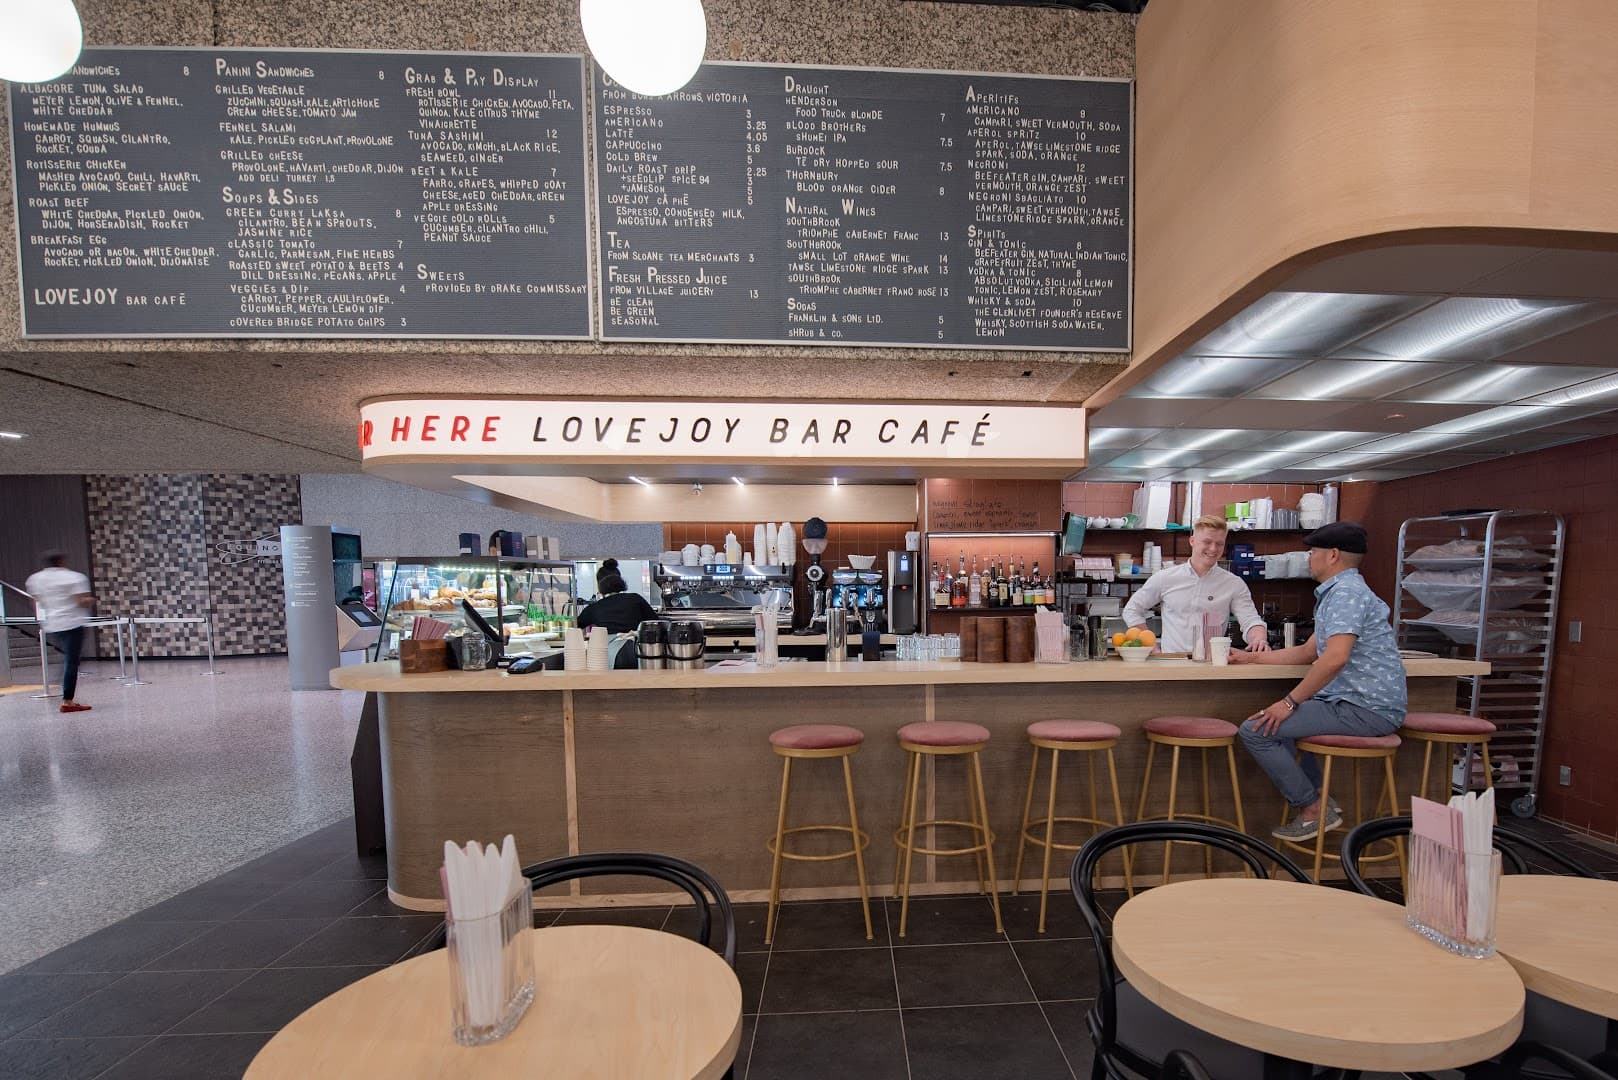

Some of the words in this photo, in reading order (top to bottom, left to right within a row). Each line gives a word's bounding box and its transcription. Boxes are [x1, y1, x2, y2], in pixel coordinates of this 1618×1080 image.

[73, 66, 120, 75] ANDWICHES
[391, 415, 500, 442] HERE
[532, 416, 740, 443] LOVEJOY
[769, 418, 851, 445] BAR
[878, 413, 990, 446] CAFÉ
